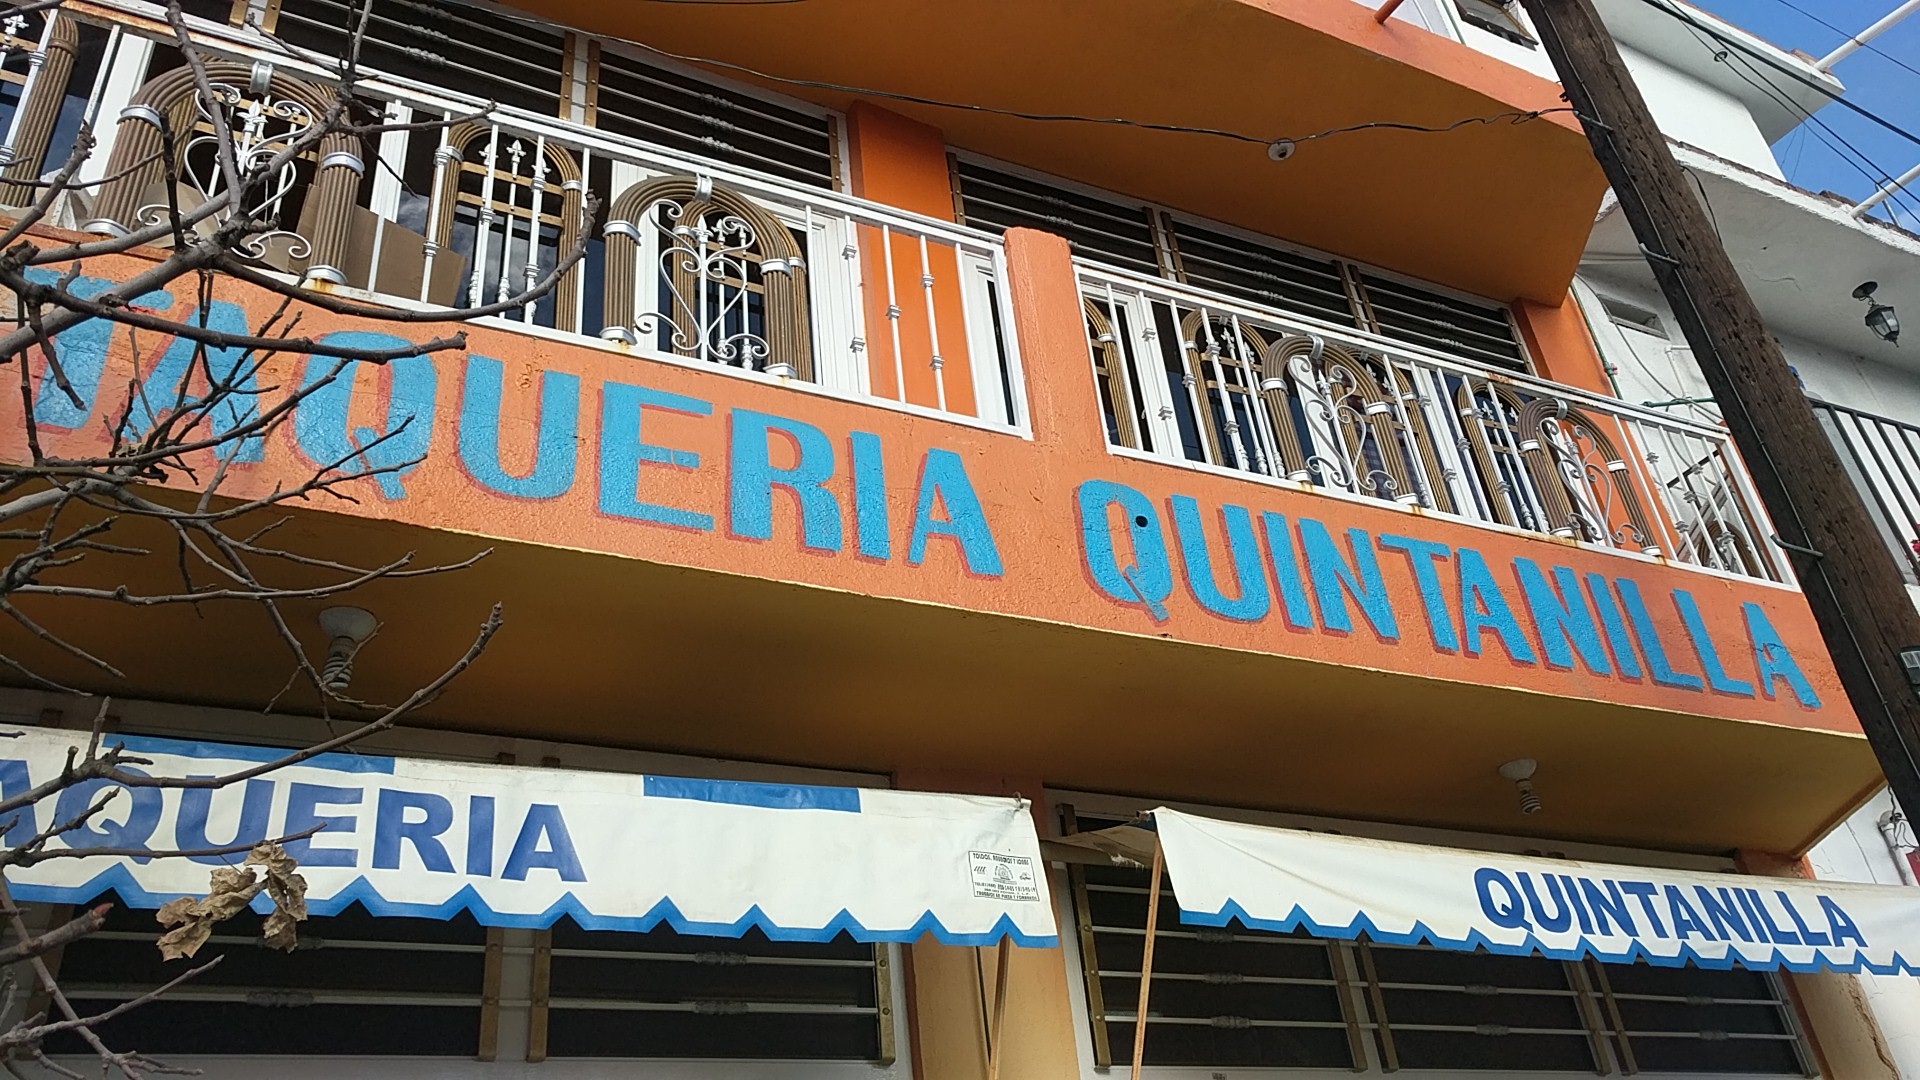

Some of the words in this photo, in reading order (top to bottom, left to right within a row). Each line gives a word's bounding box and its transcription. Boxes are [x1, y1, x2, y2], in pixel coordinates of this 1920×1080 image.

[24, 266, 1004, 576] TAQUERIA
[1078, 480, 1822, 710] QUINTANILLA
[1473, 867, 1868, 949] QUINTANILLA
